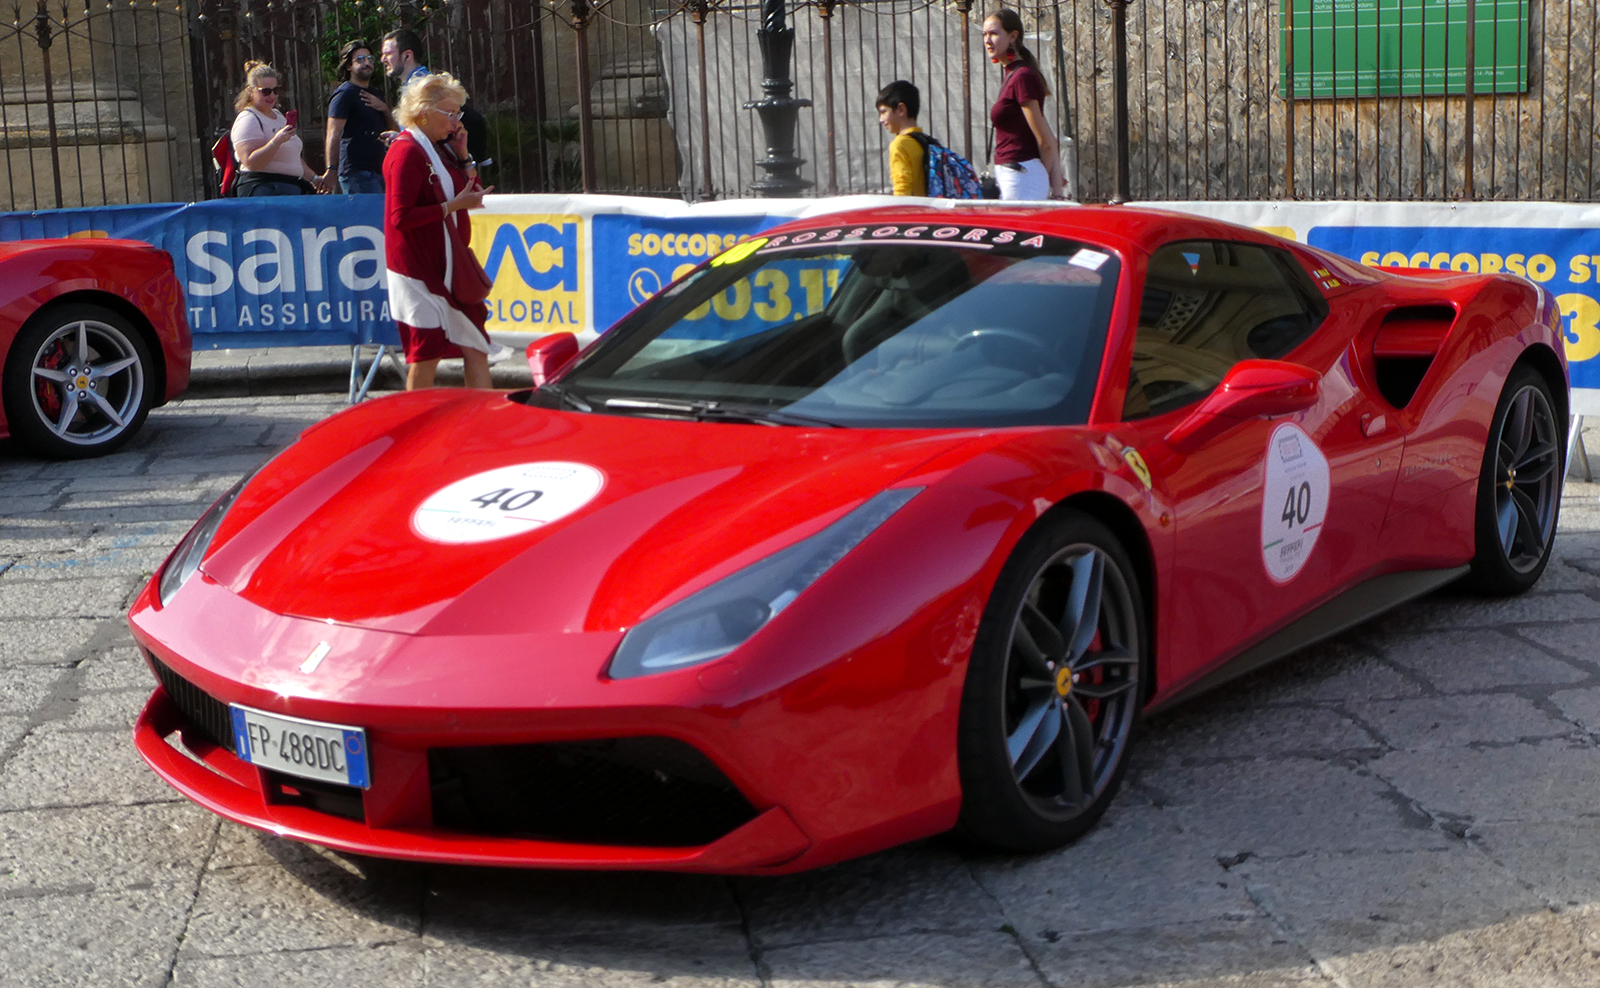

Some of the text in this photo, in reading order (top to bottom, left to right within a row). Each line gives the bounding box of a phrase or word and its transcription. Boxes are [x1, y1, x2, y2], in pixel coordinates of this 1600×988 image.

[186, 225, 389, 296] sara
[189, 300, 391, 328] TI ASSICURA
[470, 487, 544, 512] 40
[1281, 481, 1311, 530] 40
